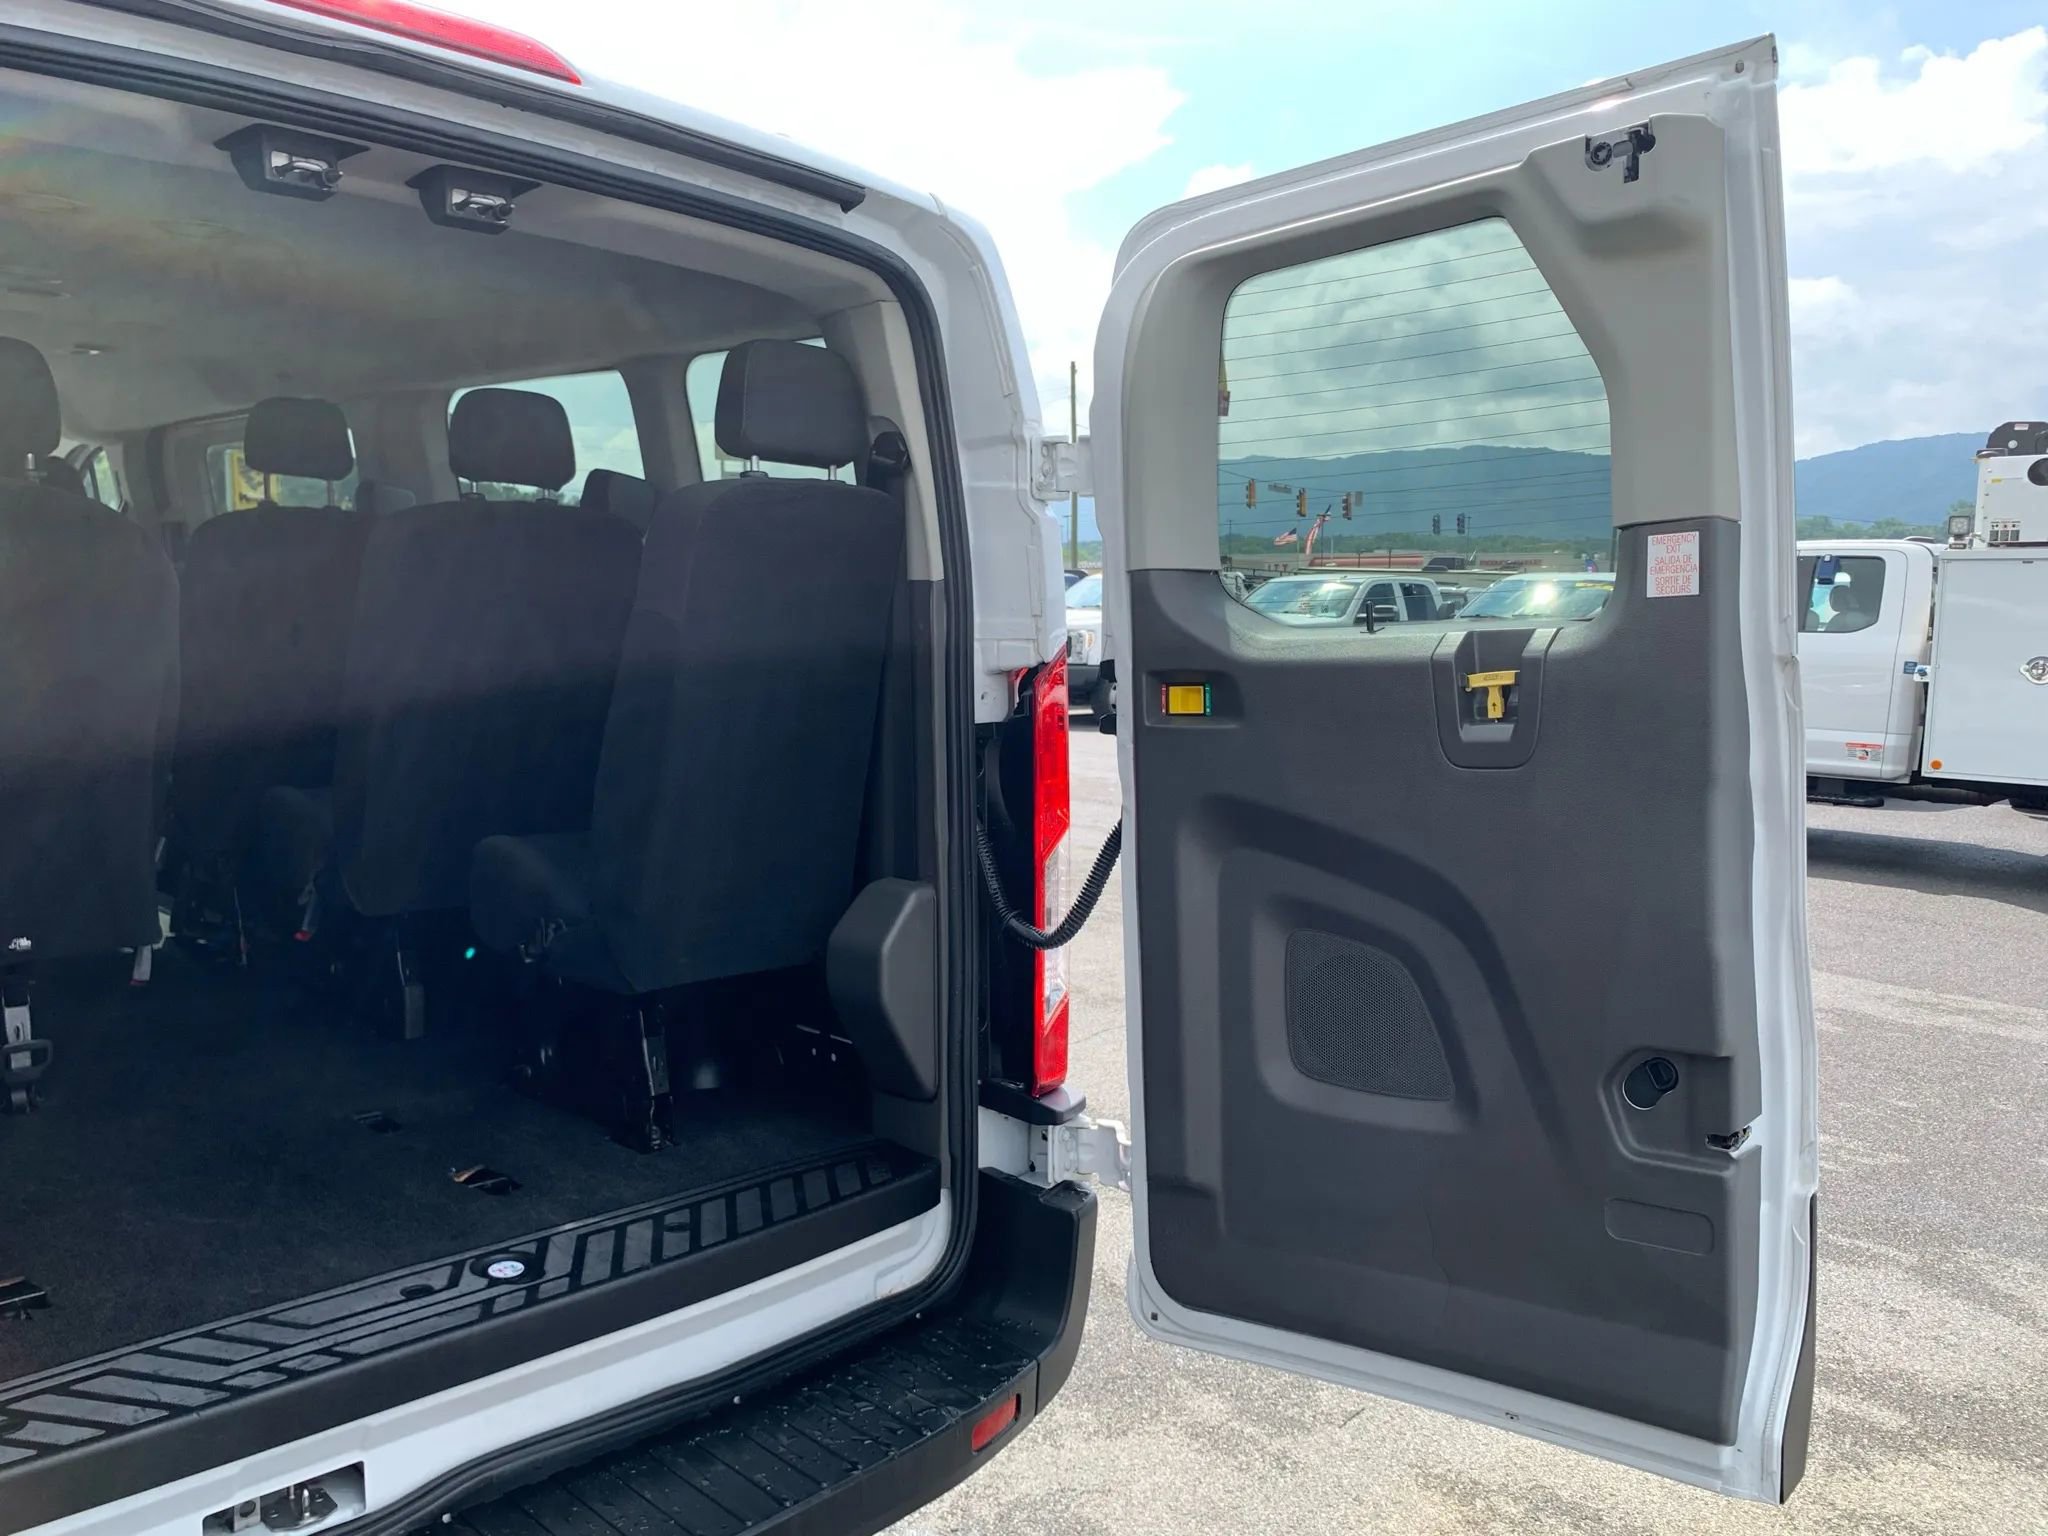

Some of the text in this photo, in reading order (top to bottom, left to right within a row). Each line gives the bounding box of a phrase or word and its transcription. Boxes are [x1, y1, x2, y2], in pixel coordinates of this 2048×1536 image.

[1652, 533, 1697, 546] EMERGENCY
[1666, 544, 1681, 553] EXIT
[1655, 554, 1693, 565] SALIDA DE
[1650, 564, 1698, 575] EMERGENCIA
[1655, 574, 1693, 586] SORTIE DE
[1656, 584, 1692, 595] SECOURS
